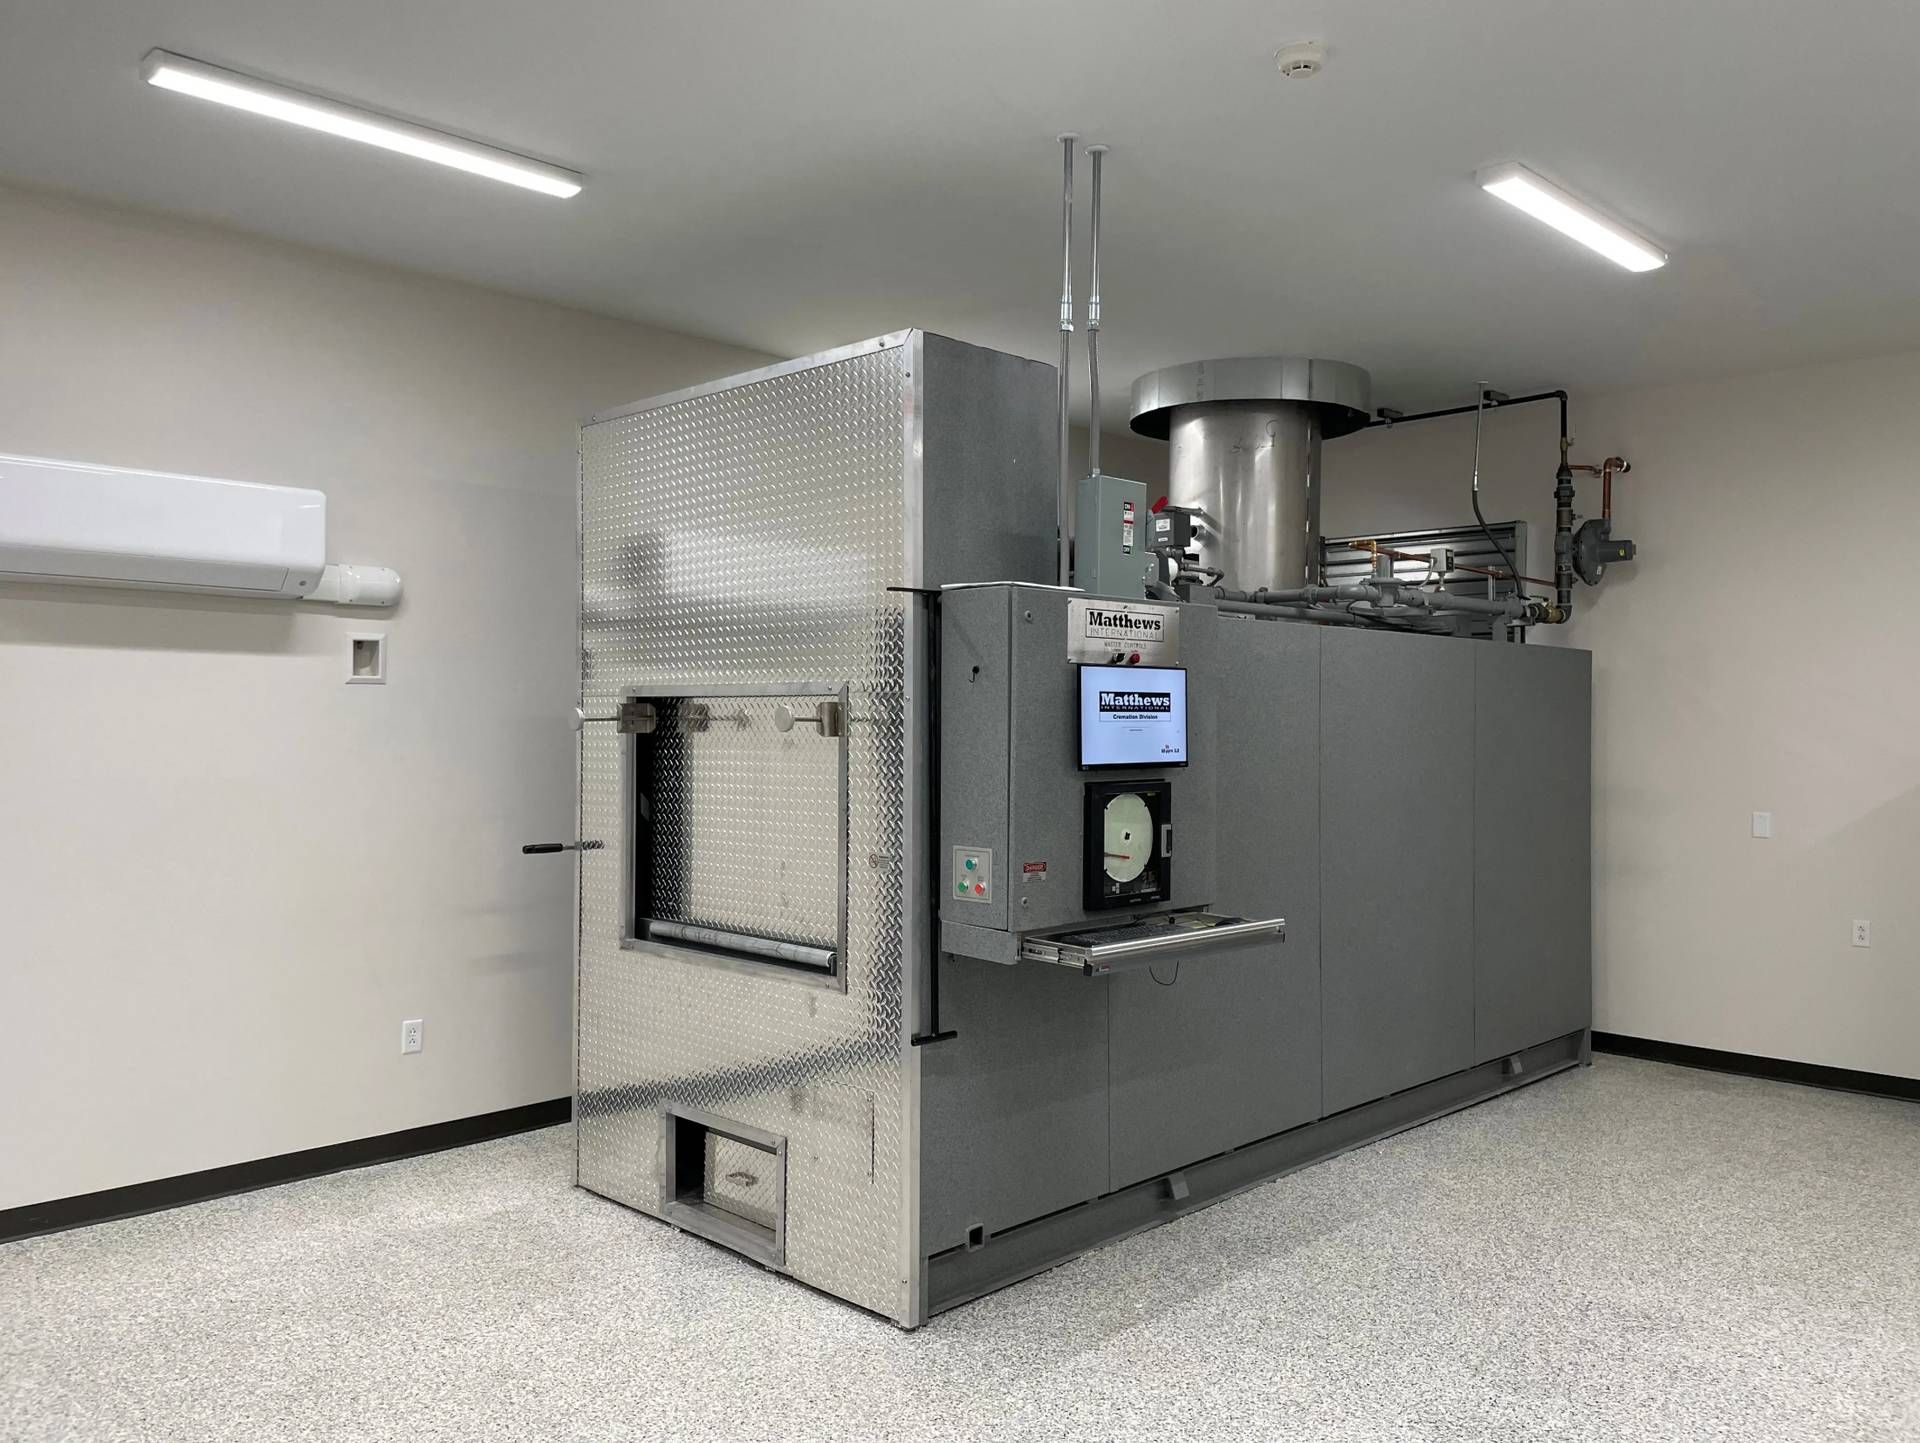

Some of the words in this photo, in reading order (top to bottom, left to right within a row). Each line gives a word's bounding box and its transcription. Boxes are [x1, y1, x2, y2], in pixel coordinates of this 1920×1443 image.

[1089, 611, 1161, 631] Matthews
[1090, 627, 1160, 640] INTERNATIONAL
[1101, 693, 1170, 706] Matthews
